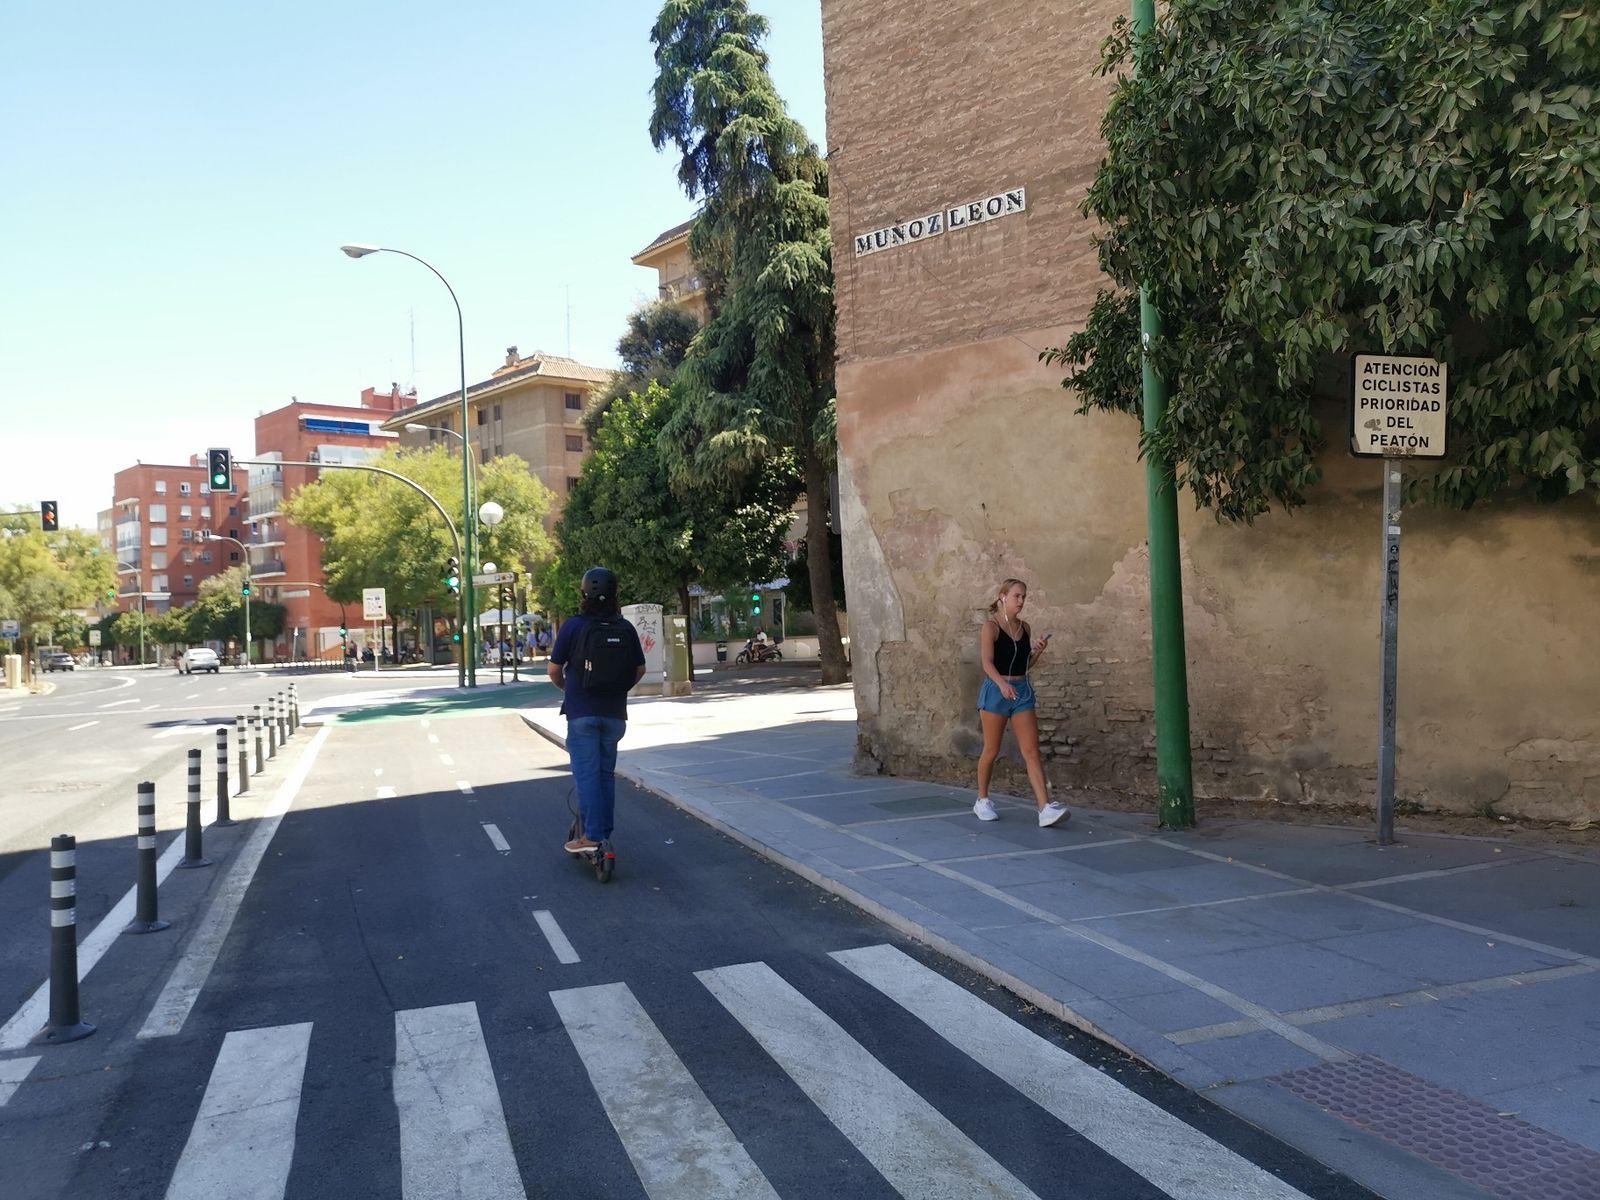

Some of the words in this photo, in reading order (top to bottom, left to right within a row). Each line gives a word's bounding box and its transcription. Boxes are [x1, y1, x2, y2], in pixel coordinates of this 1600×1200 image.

[949, 189, 1024, 228] LEON
[1363, 361, 1440, 377] ATENCIÓN
[1362, 379, 1440, 395] CICLISTAS
[1360, 397, 1441, 412] PRIORIDAD
[1386, 416, 1414, 429] DEL
[1370, 432, 1430, 448] PEATÓN
